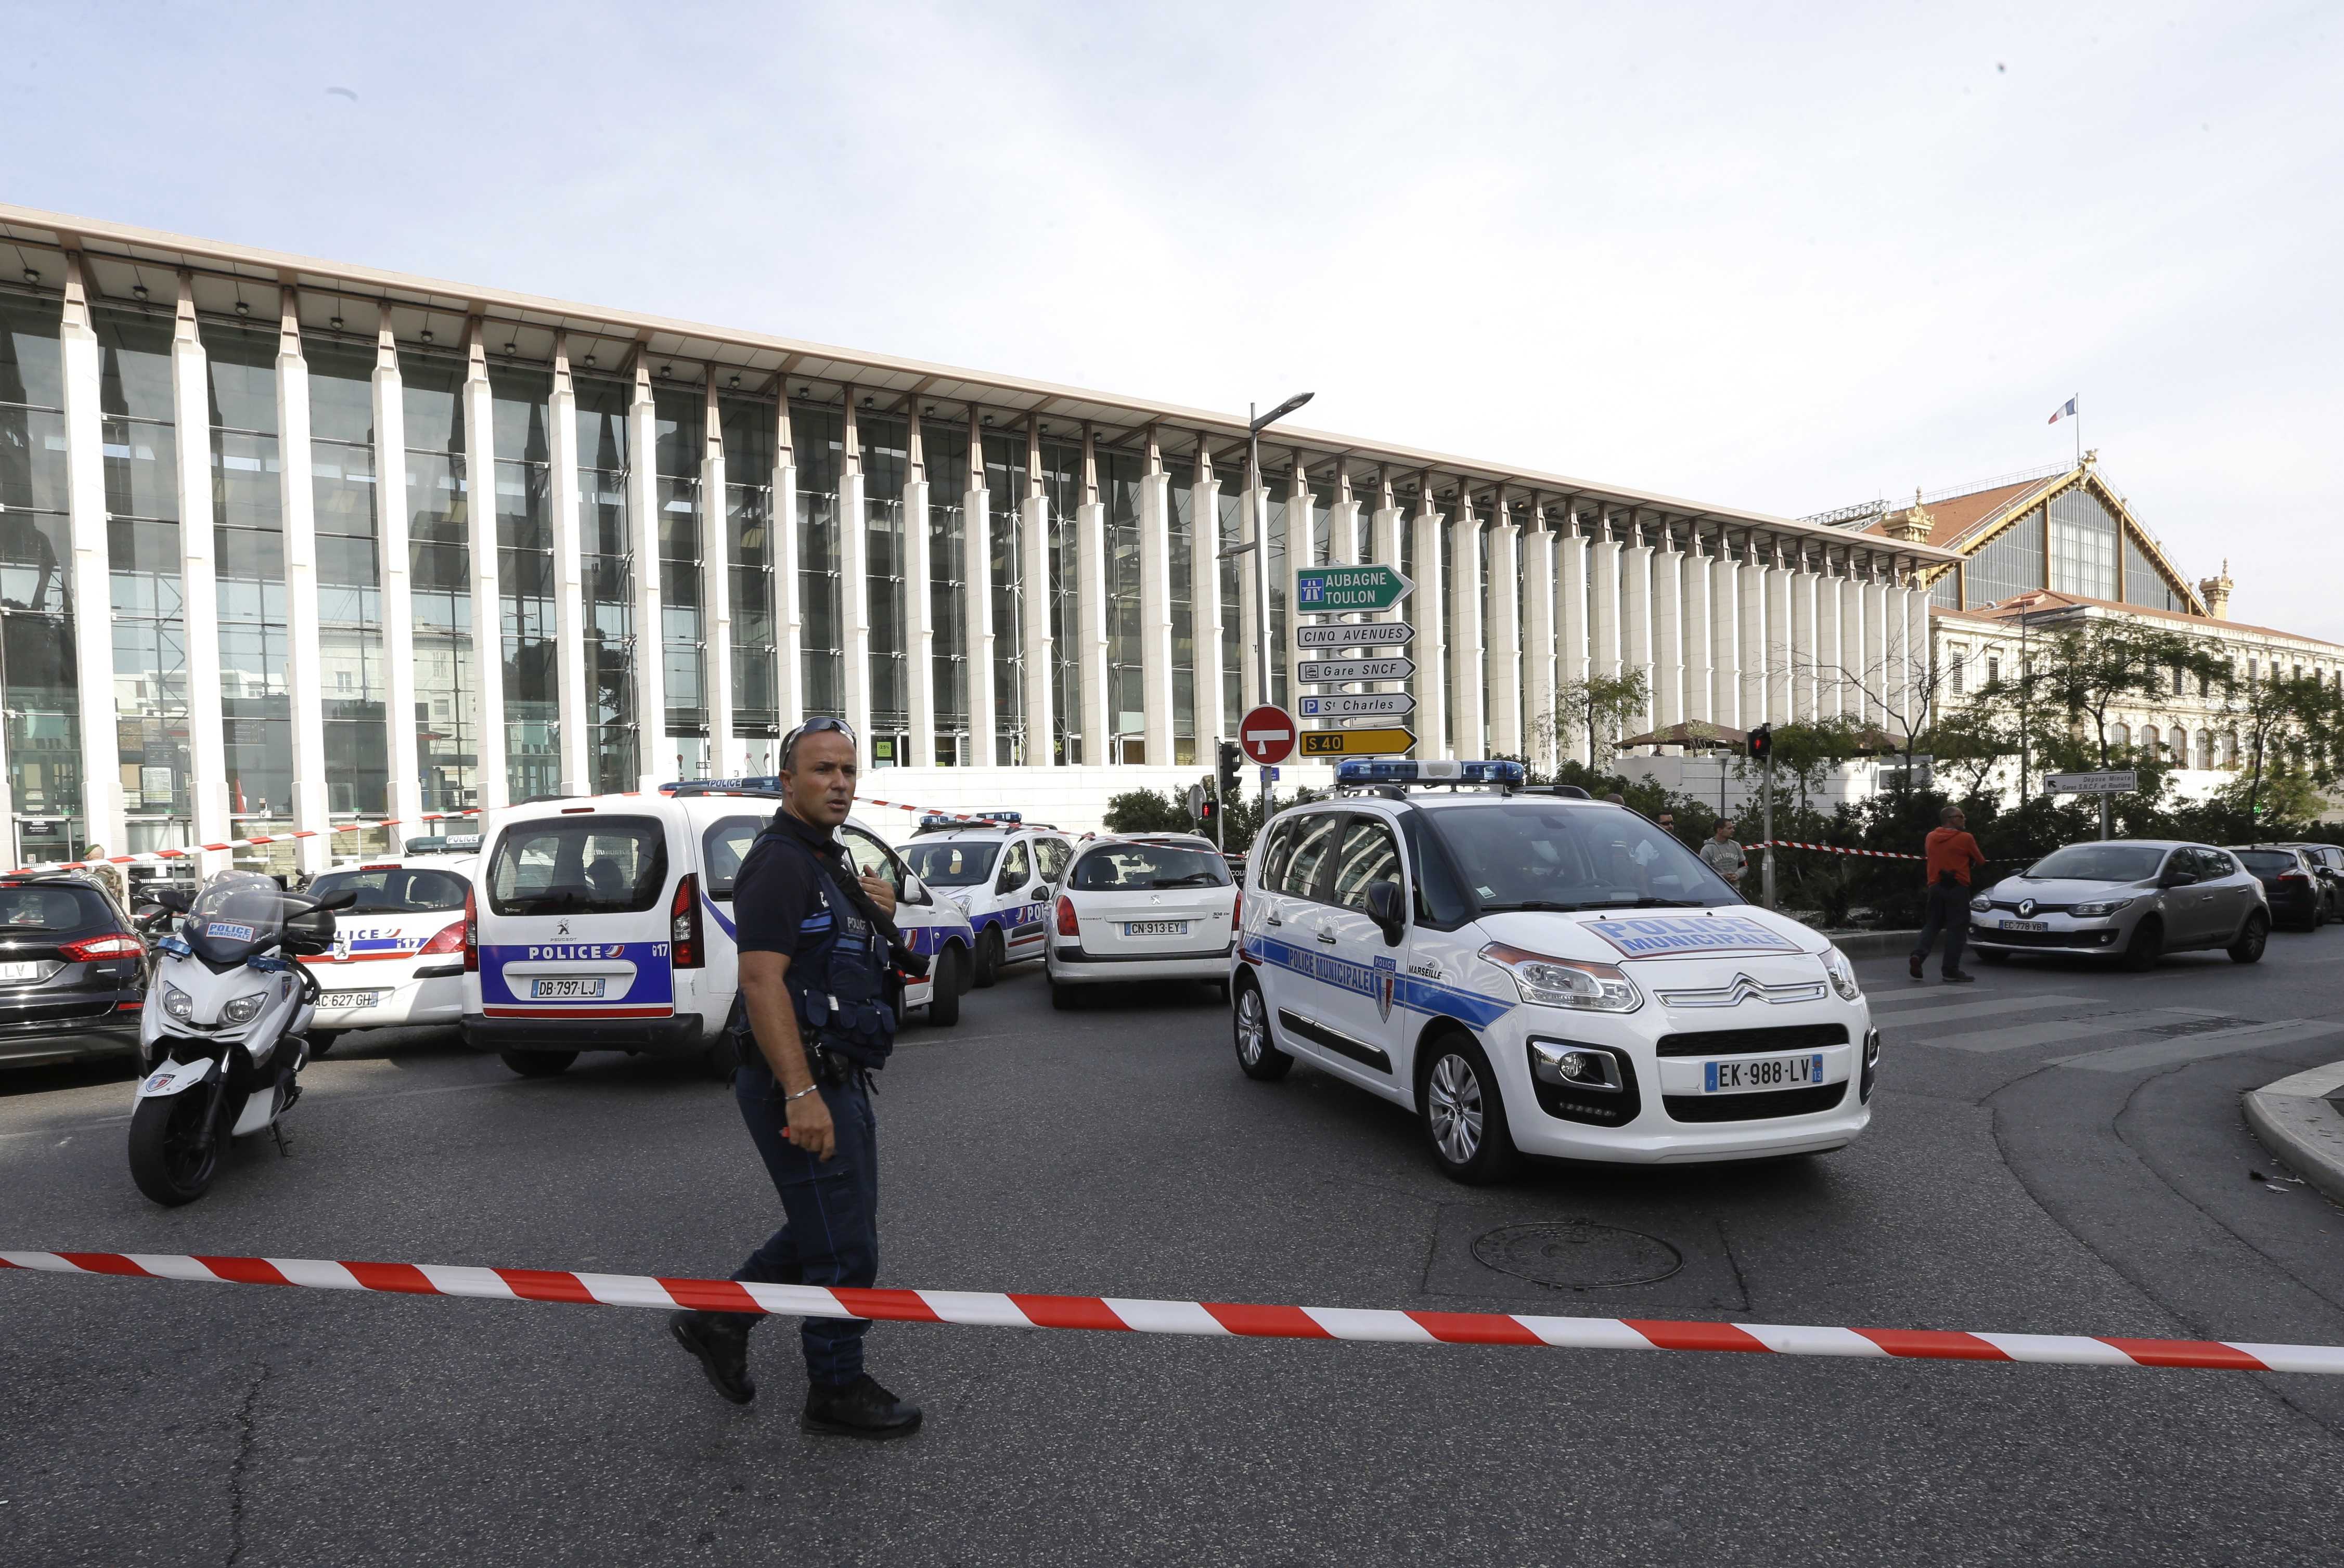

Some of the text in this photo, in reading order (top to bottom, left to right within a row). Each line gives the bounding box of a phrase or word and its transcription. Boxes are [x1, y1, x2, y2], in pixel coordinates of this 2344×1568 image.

[1325, 573, 1387, 587] AUBAGNE
[1325, 590, 1375, 604] TOULON
[1304, 628, 1403, 642] CINQ AVENUES
[1324, 663, 1397, 676] Gare SNCF
[1307, 699, 1393, 712] P St Charles
[1309, 737, 1341, 749] S 40
[209, 924, 252, 936] POLICE
[1132, 922, 1180, 934] CN-913-EY
[1593, 918, 1763, 938] POLICE
[2004, 921, 2042, 931] EC-778-VB
[208, 931, 250, 940] MUNICIPALE
[1619, 934, 1786, 951] MUNICIPALE
[403, 938, 420, 948] 17
[529, 944, 668, 959] POLICE 17
[1290, 948, 1369, 991] POLICE MUNICIPALE
[1375, 958, 1395, 969] POLICE
[1408, 965, 1442, 980] MARSEILLE
[538, 981, 597, 995] DB-797-LJ
[1719, 1059, 1809, 1087] EK-988-LV
[1813, 1071, 1821, 1081] 13
